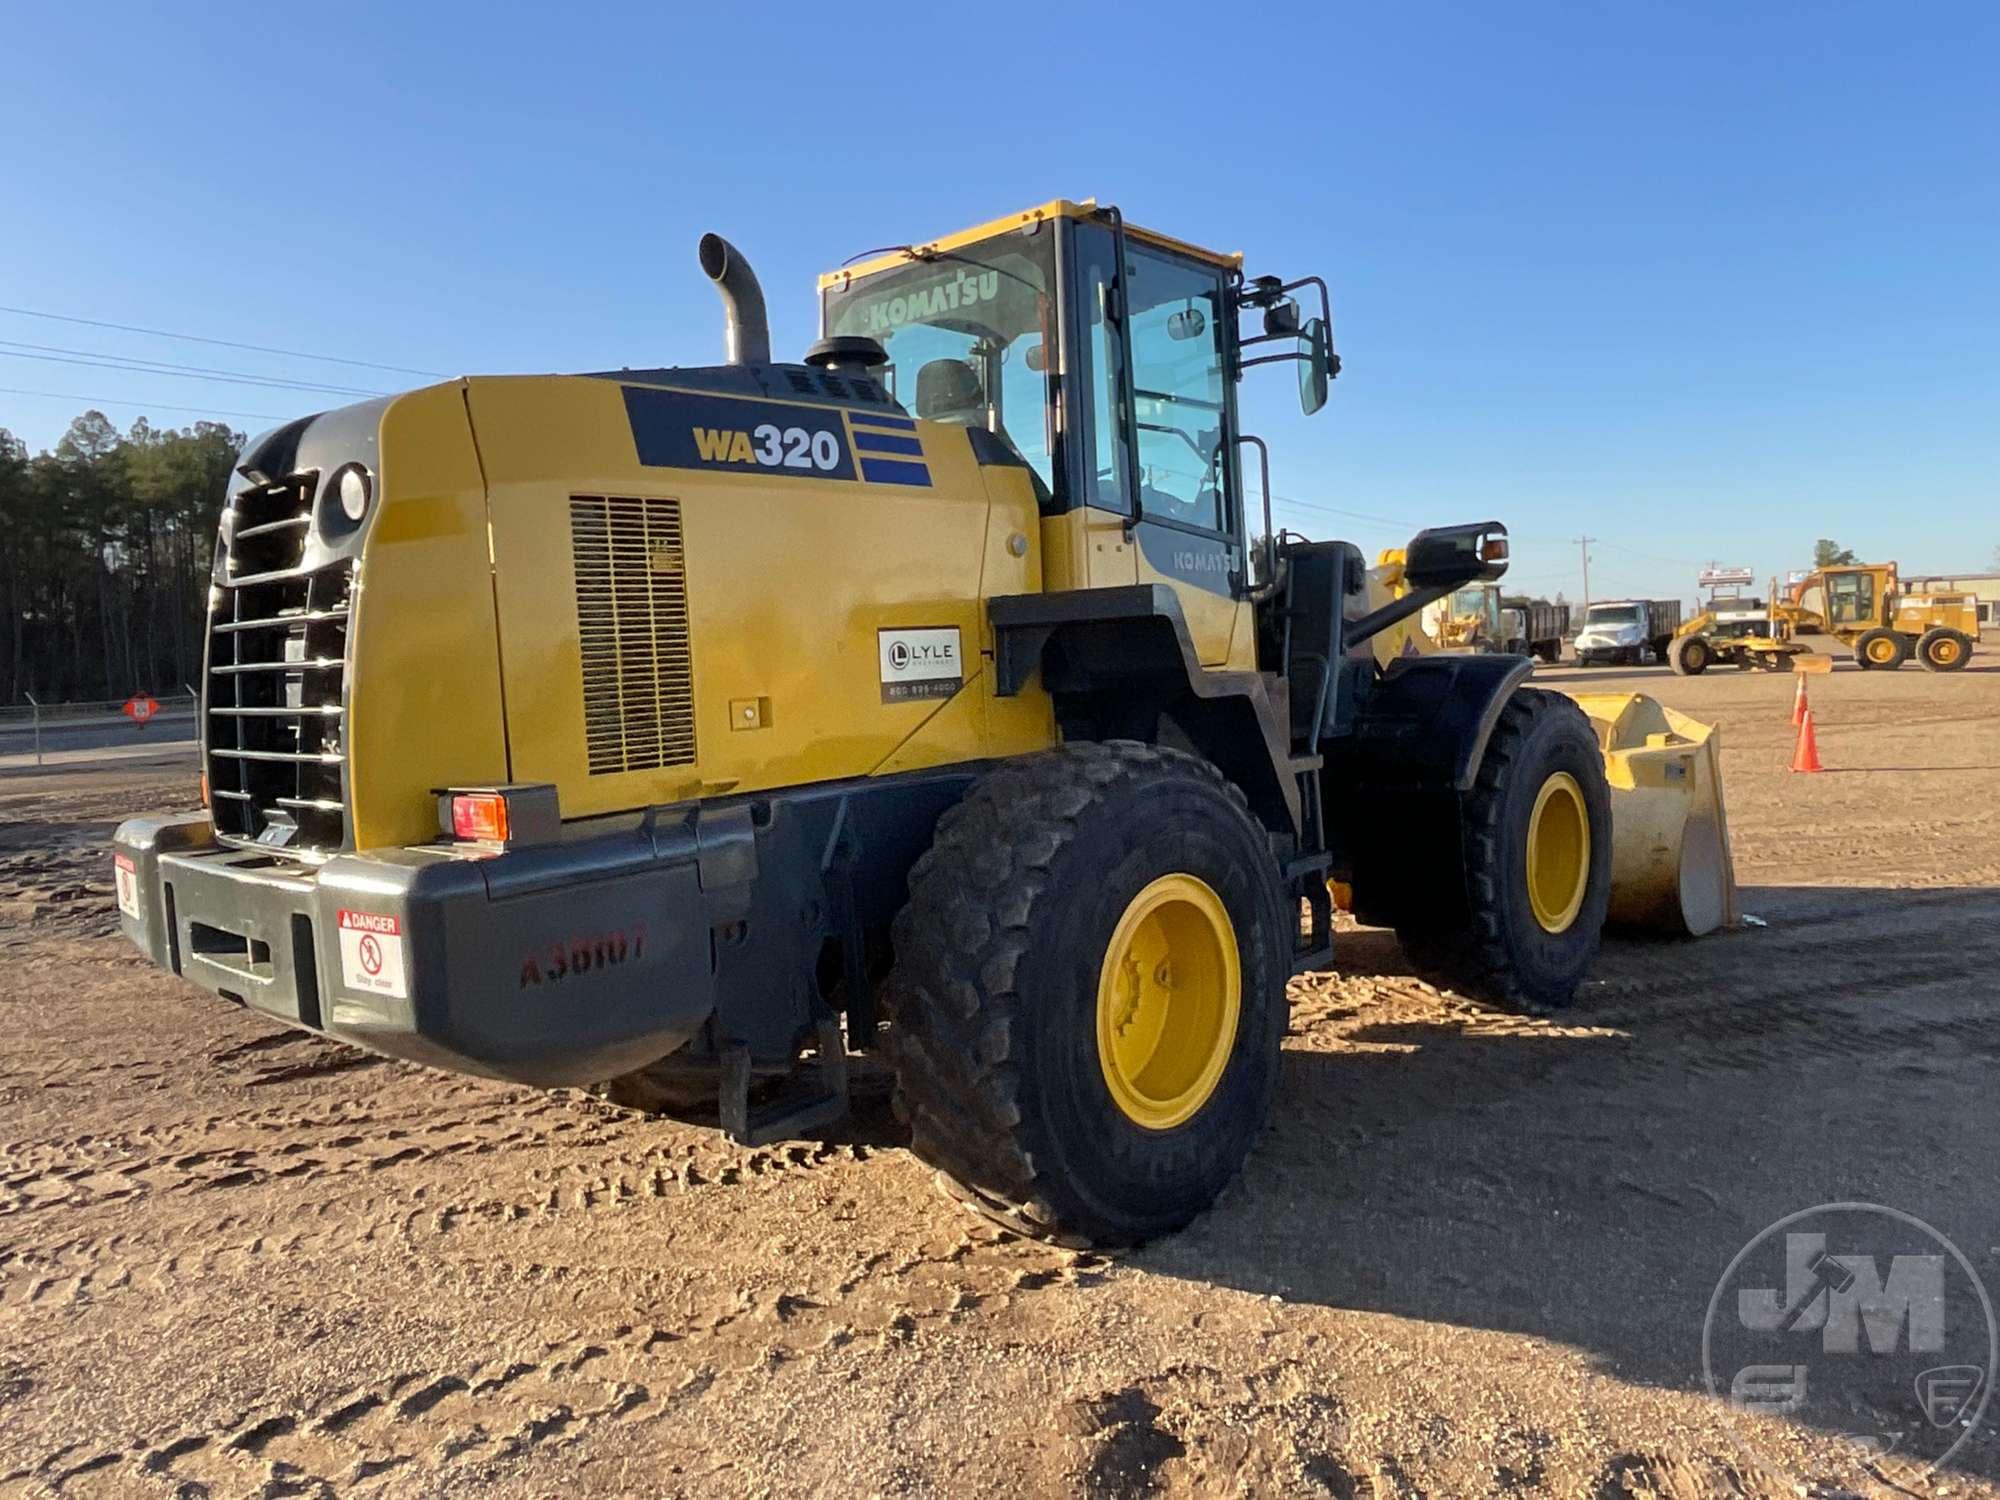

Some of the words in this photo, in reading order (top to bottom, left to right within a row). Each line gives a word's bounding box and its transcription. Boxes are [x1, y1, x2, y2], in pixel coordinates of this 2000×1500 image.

[870, 268, 998, 330] KOMATSU
[692, 424, 839, 471] WA320
[1173, 548, 1240, 573] KOMATSU
[912, 645, 953, 659] LYLE
[352, 912, 396, 934] DANGER
